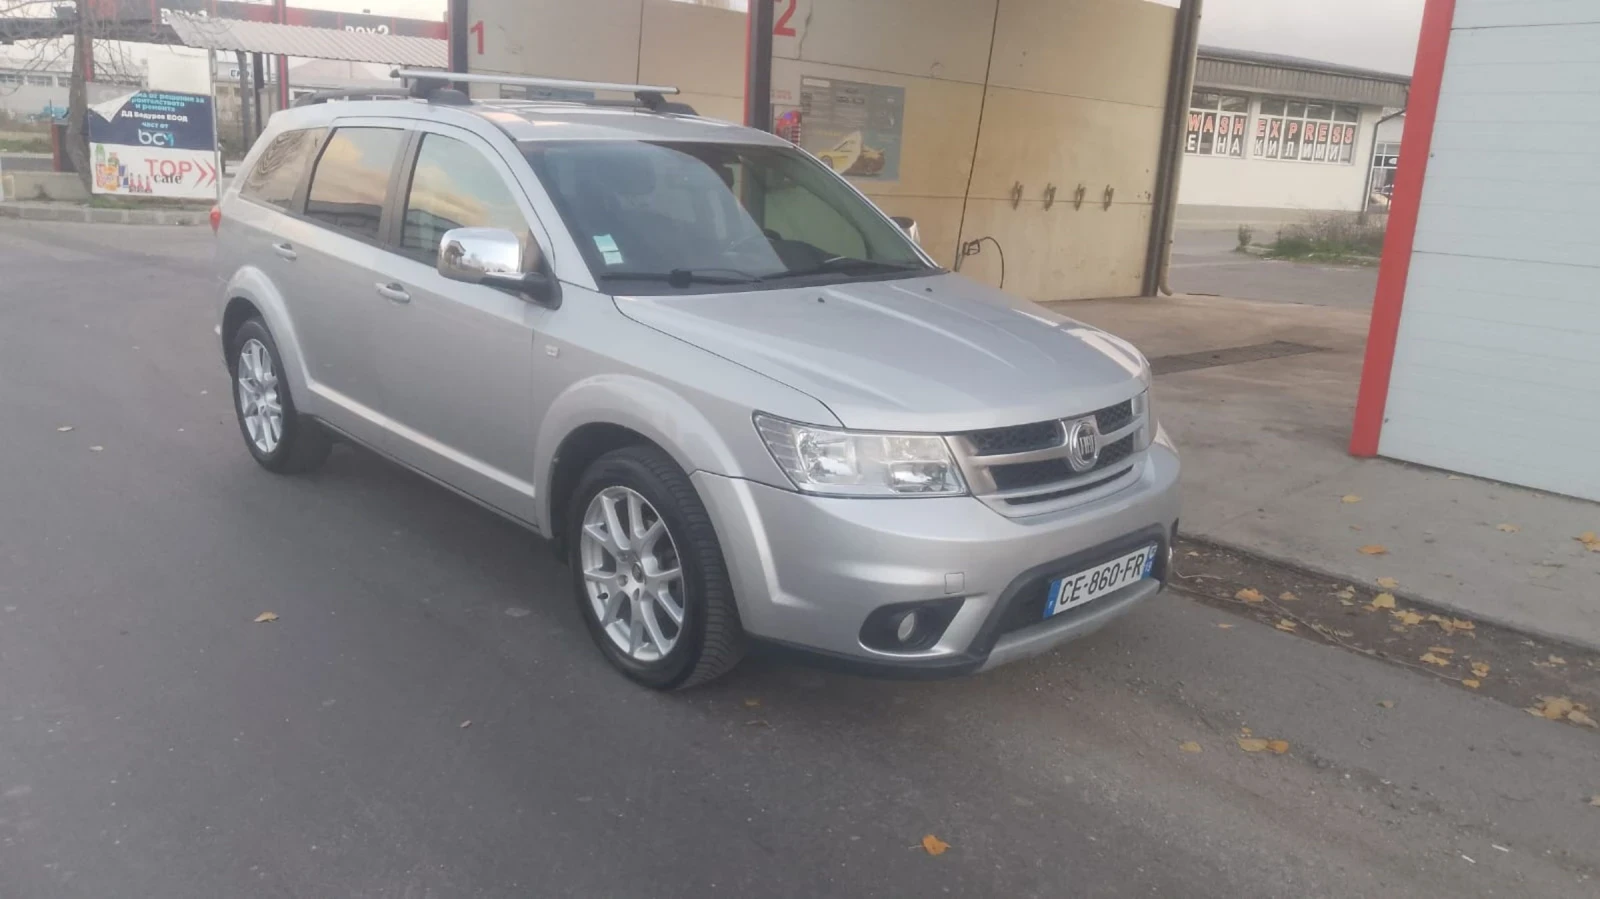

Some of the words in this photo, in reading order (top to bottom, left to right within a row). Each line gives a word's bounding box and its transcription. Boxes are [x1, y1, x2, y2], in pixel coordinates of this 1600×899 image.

[773, 0, 796, 36] 2
[470, 20, 484, 55] 1
[1187, 114, 1246, 135] WASH
[1256, 118, 1355, 144] EXPRESS
[1216, 138, 1242, 154] НА
[1254, 139, 1340, 160] КИЛИМИ
[144, 158, 193, 177] TOP
[1060, 553, 1145, 605] CE-860-FR
